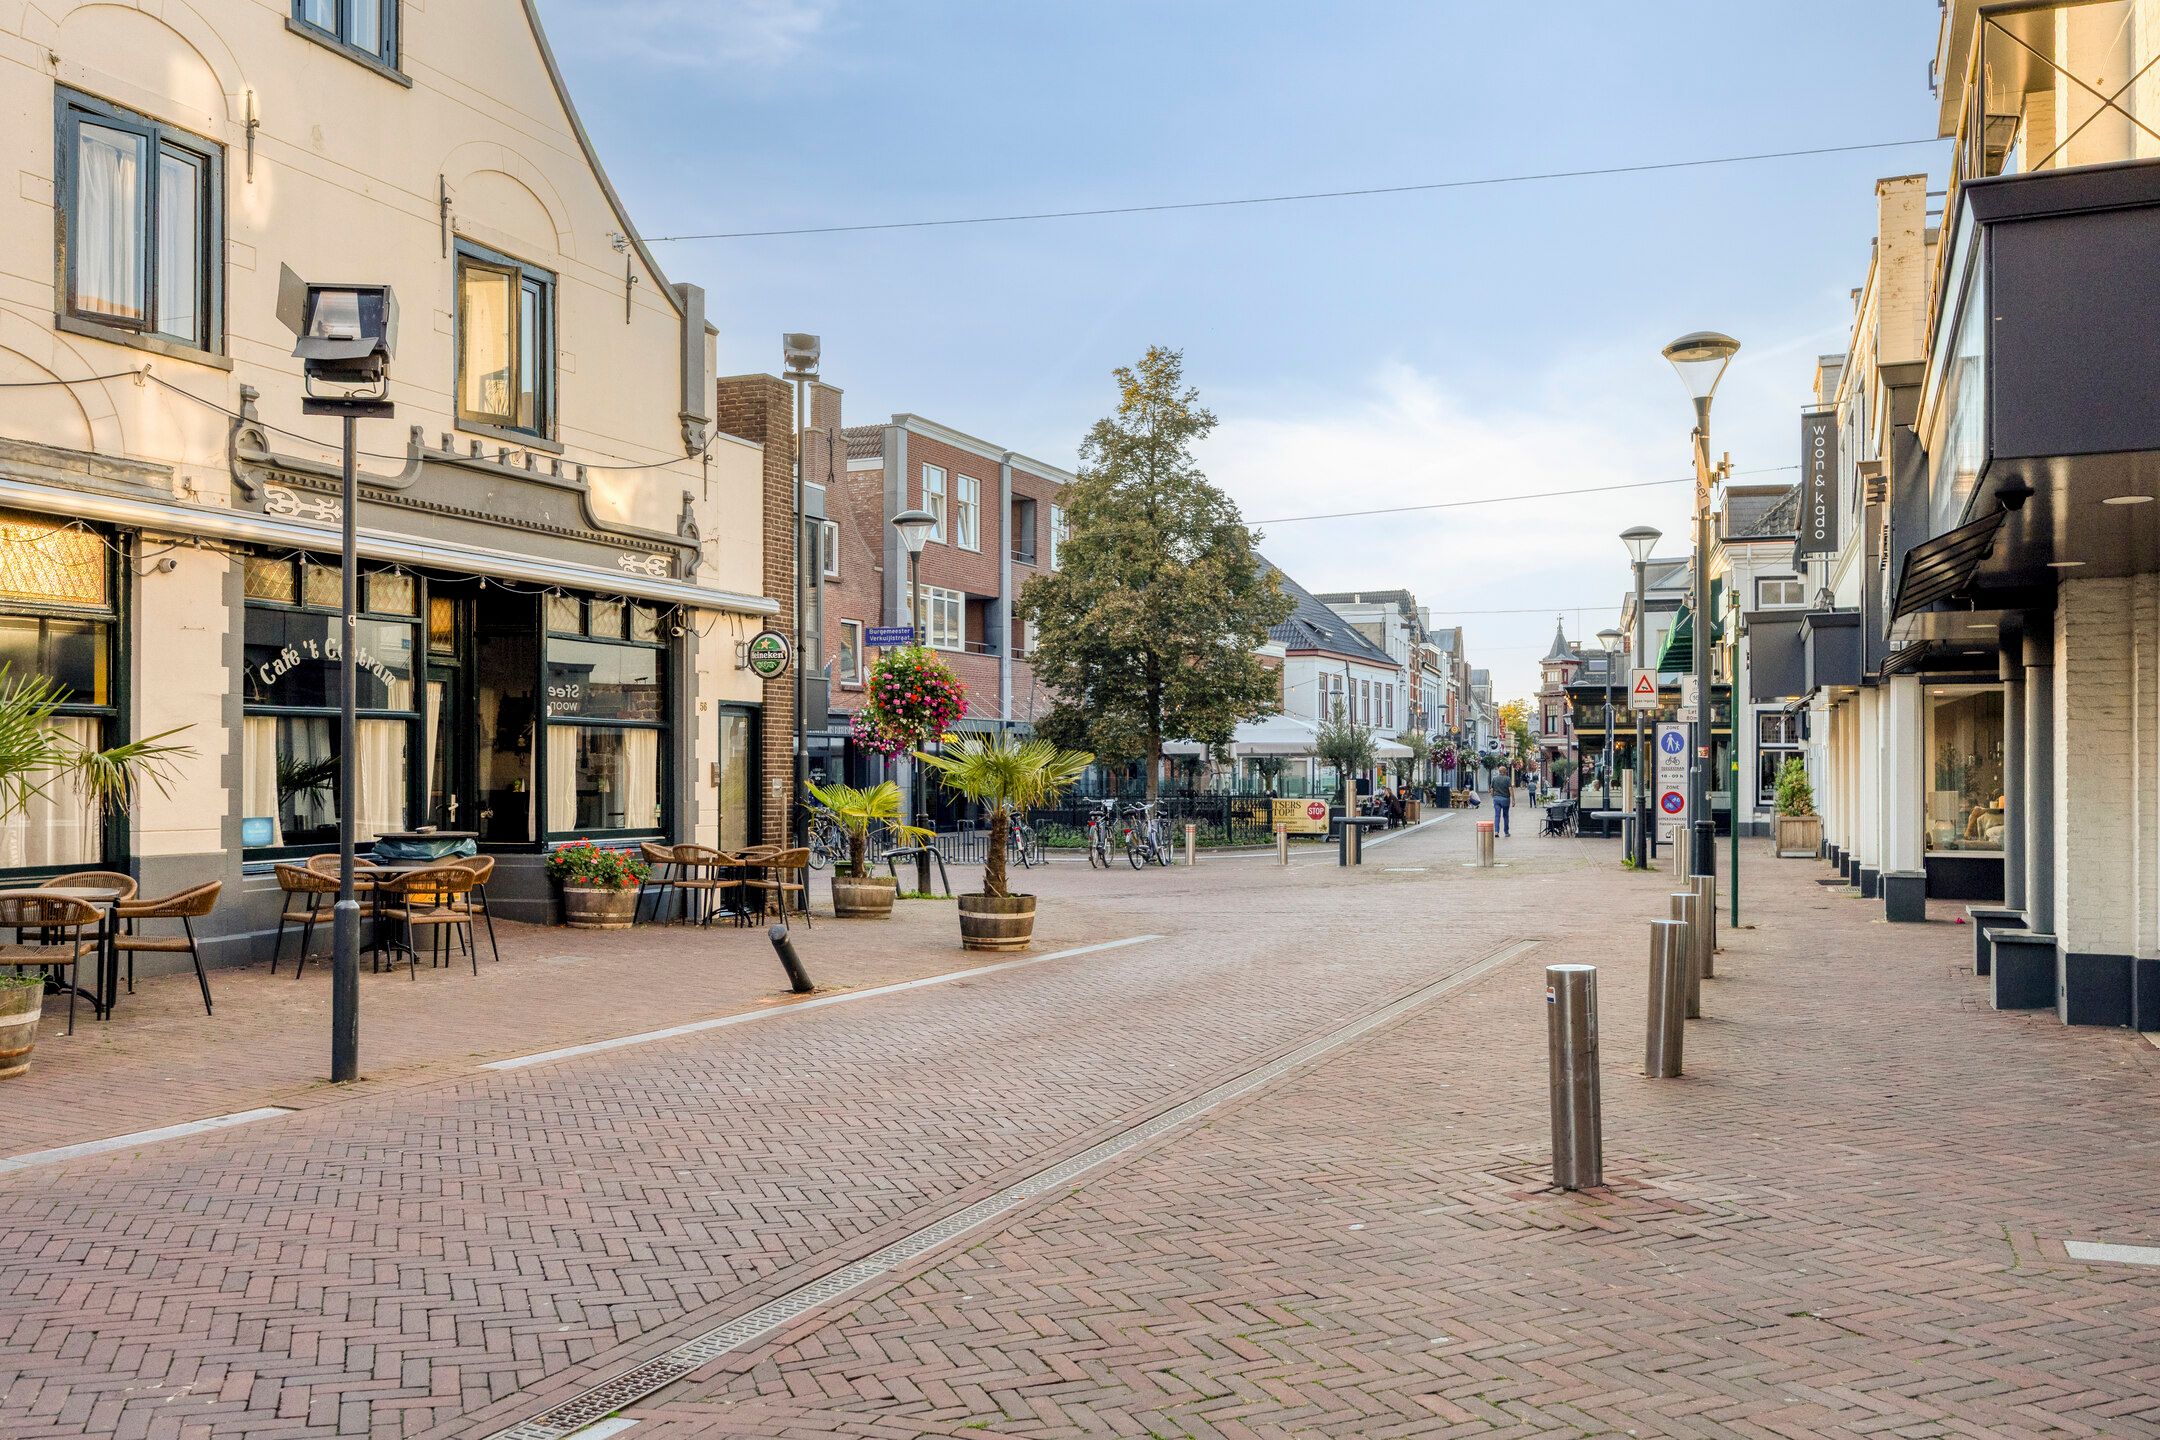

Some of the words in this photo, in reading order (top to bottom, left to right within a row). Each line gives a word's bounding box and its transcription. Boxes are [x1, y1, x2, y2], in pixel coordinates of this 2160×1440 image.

[1813, 425, 1826, 470] woon
[1814, 475, 1825, 487] &
[1814, 491, 1826, 540] kado
[260, 643, 301, 685] Café
[303, 638, 320, 659] 't
[700, 702, 708, 711] 56
[1308, 807, 1324, 815] STOP
